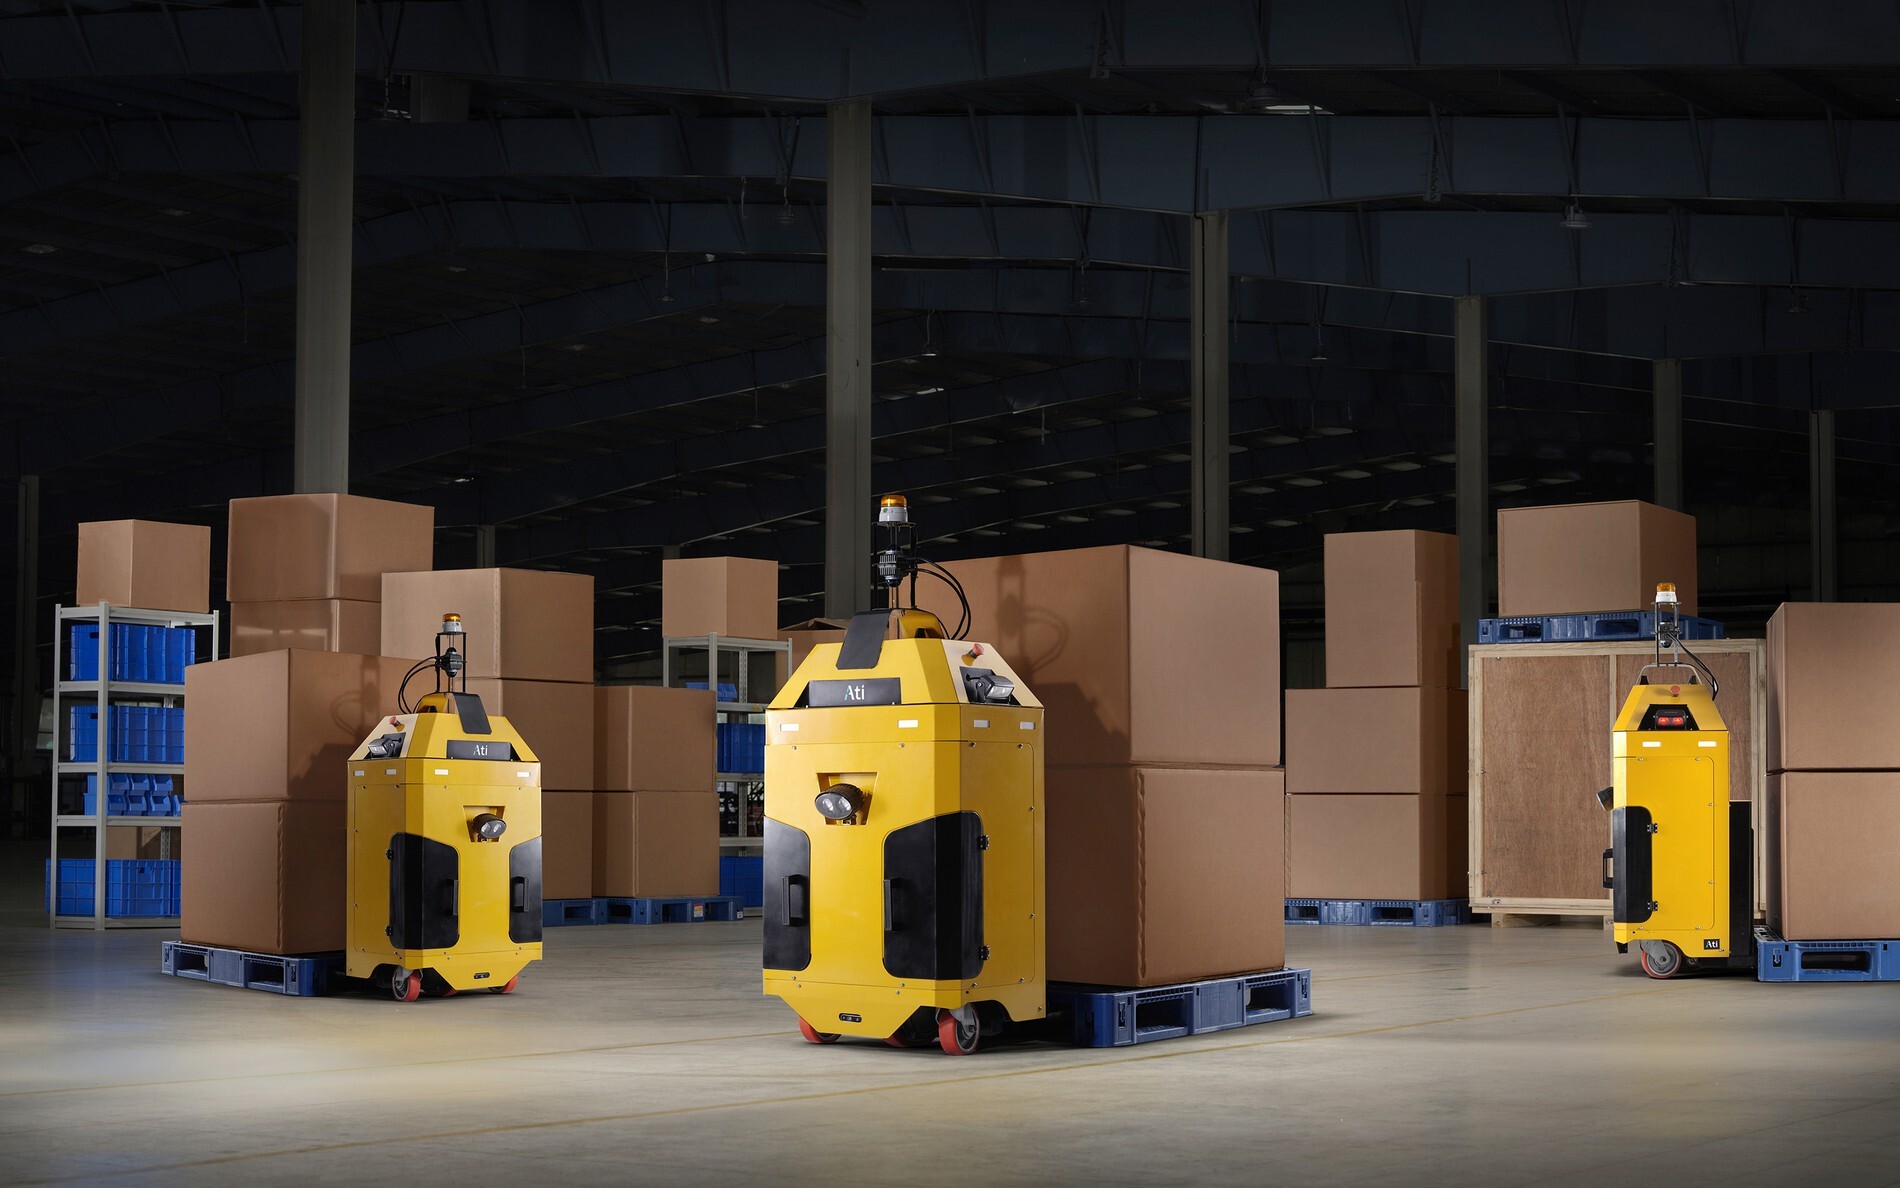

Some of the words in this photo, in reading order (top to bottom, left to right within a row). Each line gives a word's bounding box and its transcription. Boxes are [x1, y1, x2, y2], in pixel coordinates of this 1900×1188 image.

[844, 684, 865, 701] Ati
[473, 744, 488, 756] Ati
[1705, 940, 1718, 948] Ati
